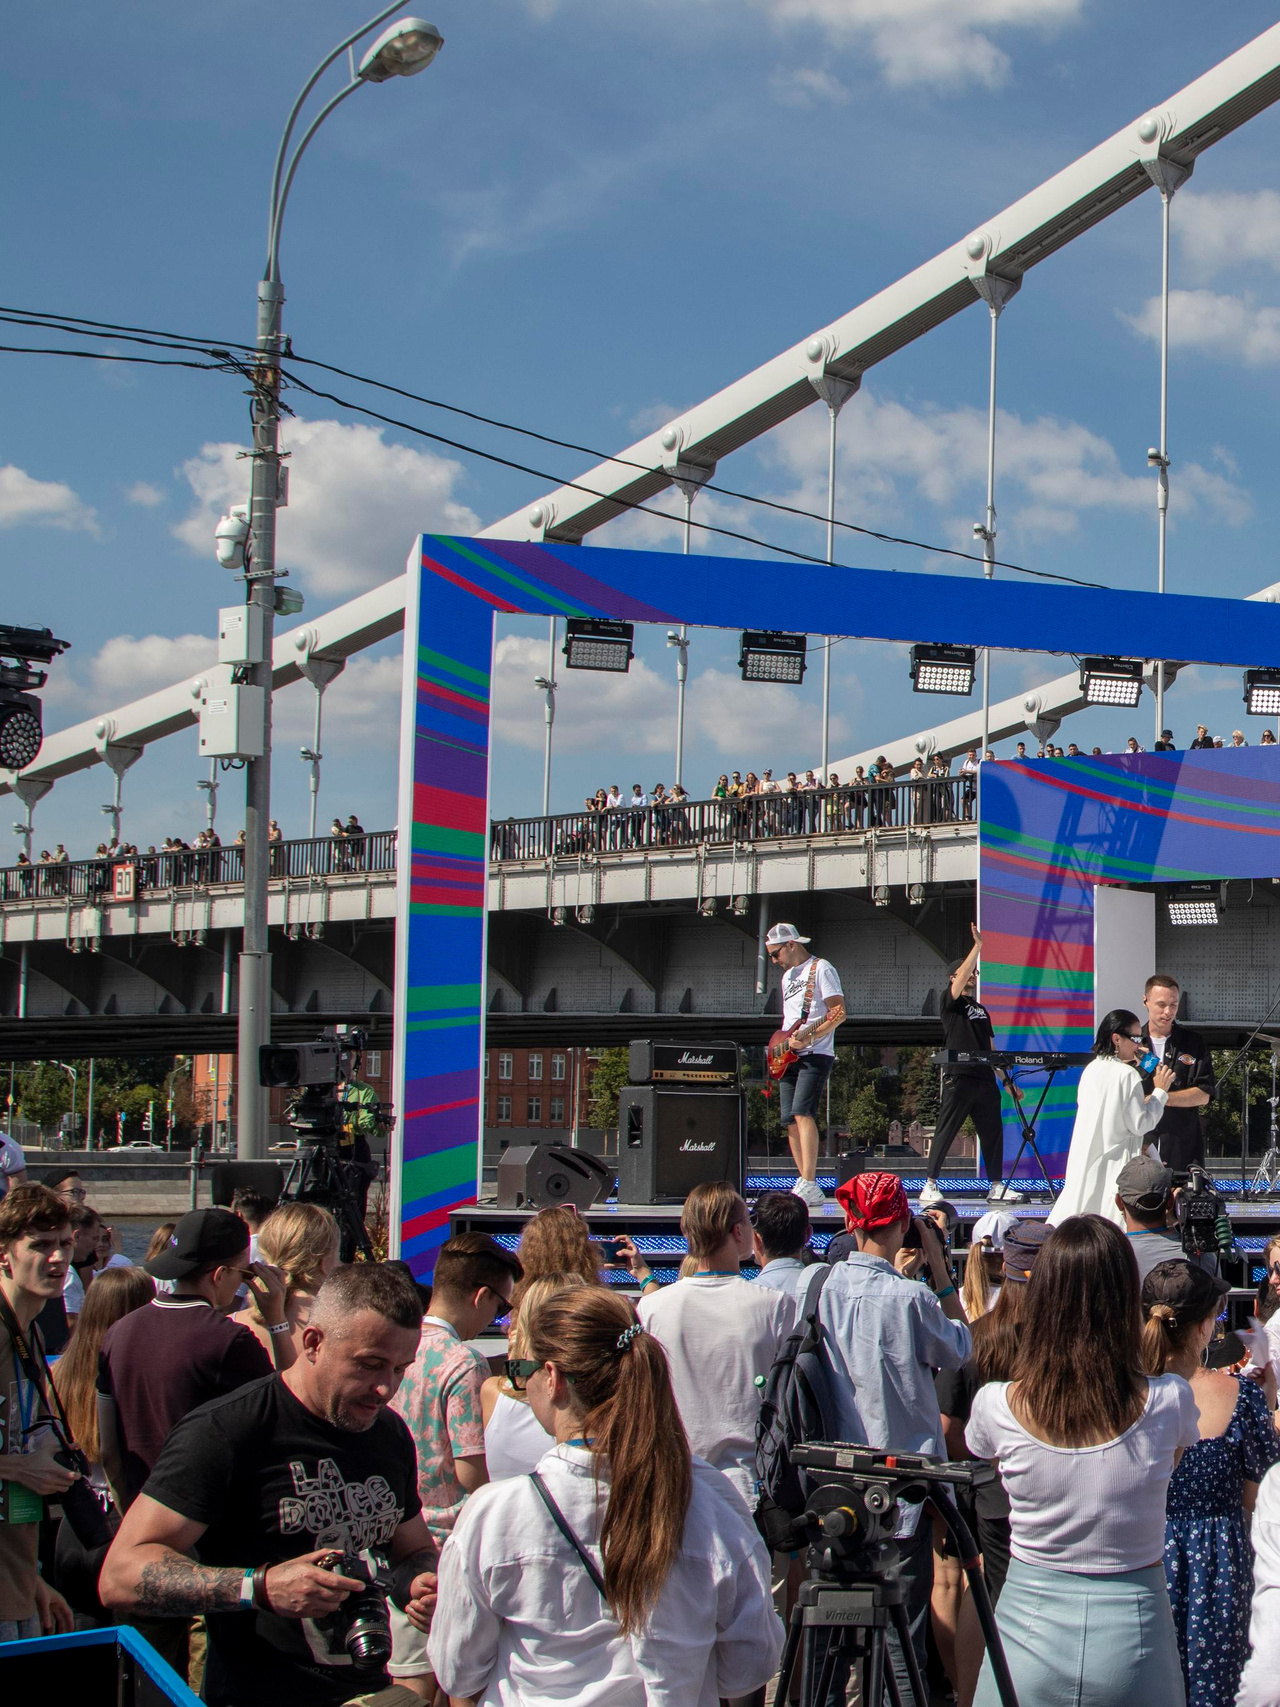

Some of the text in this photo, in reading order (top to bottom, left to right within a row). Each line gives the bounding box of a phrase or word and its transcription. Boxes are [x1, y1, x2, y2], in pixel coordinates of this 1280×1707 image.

[678, 1051, 713, 1065] Marshall
[1015, 1056, 1043, 1064] Roland
[680, 1139, 716, 1152] Marshall
[289, 1458, 347, 1495] LA
[279, 1475, 397, 1535] DOLCE
[825, 1610, 862, 1623] Vinten
